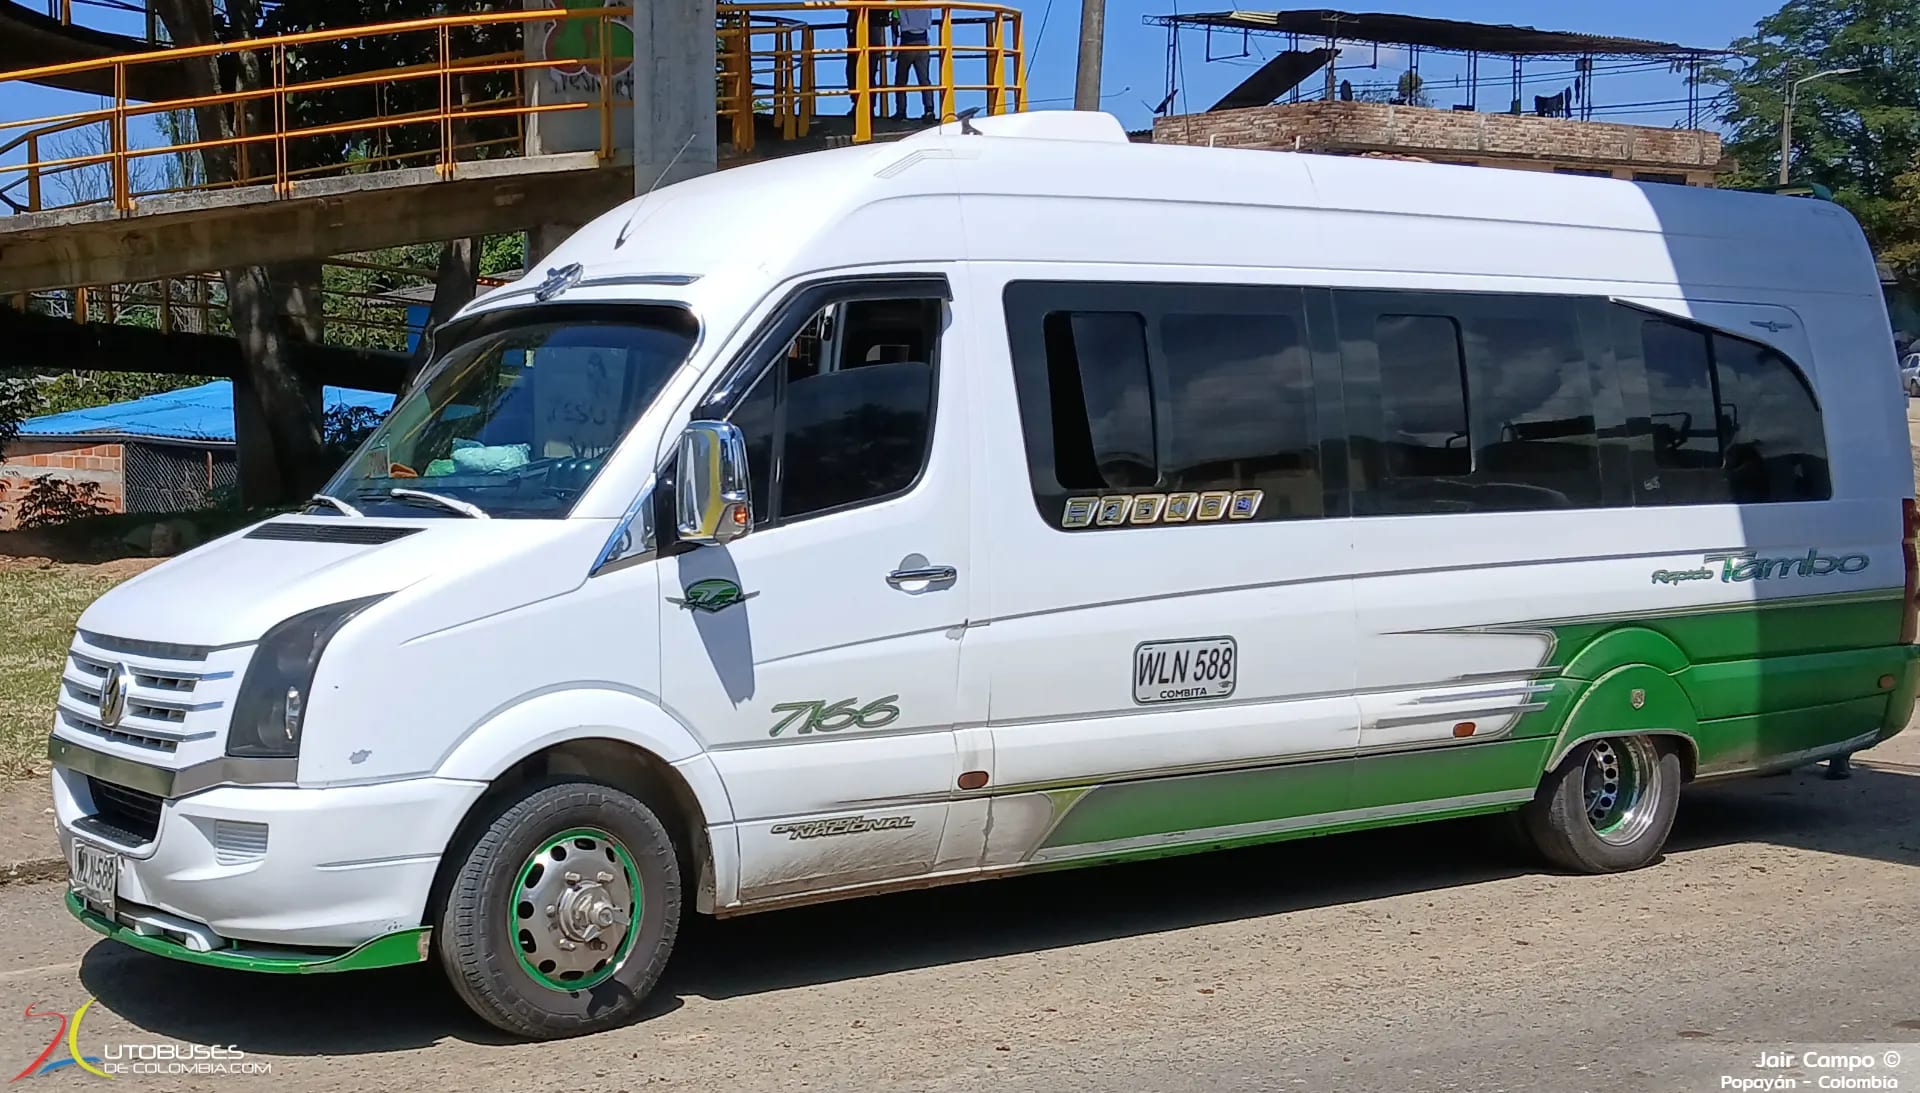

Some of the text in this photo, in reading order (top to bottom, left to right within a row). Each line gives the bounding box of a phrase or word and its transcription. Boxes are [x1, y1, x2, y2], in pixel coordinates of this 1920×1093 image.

[1704, 547, 1870, 583] Tambo
[1139, 647, 1233, 686] WLN 588
[1160, 687, 1207, 699] COMBITA
[769, 694, 900, 738] 7166
[789, 816, 916, 840] NACIONAL
